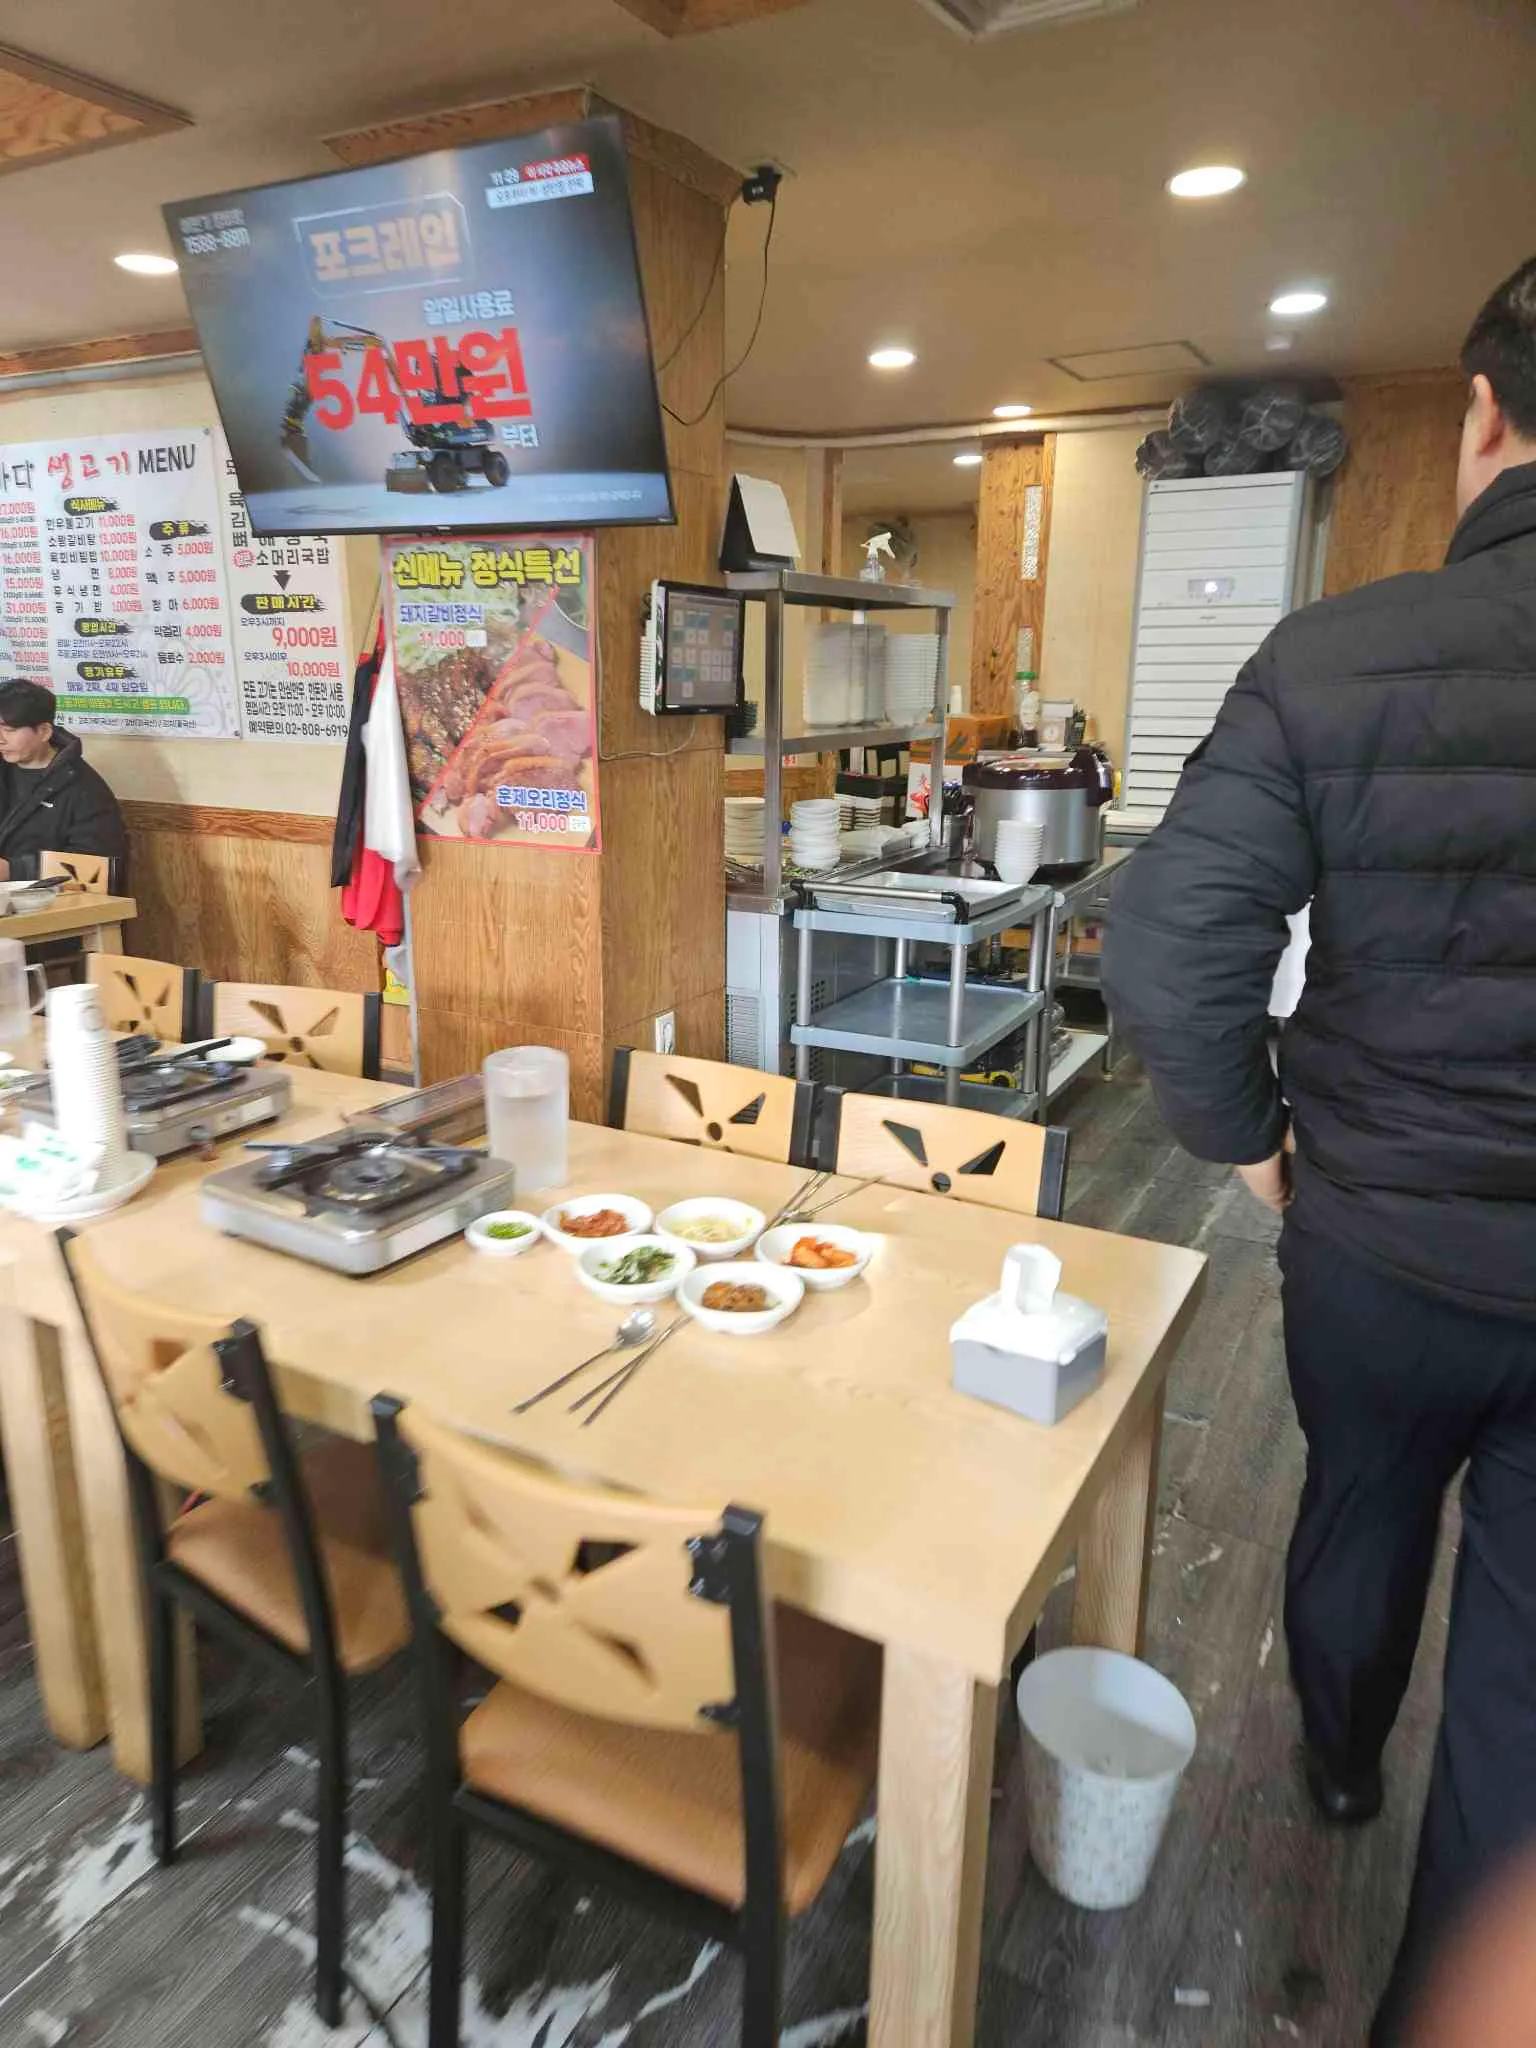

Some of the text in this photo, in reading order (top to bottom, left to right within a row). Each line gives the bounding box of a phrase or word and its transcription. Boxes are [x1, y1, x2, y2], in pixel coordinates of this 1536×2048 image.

[309, 211, 463, 281] 포크레인
[423, 289, 515, 325] 일일사용료
[303, 327, 533, 432] 54만원
[501, 423, 540, 448] 부터
[48, 451, 131, 490] 생고기
[138, 444, 196, 474] MENU
[256, 547, 329, 566] 소머리국밥
[394, 548, 581, 589] 신메뉴 정식특선
[255, 595, 315, 609] 판매시간
[399, 603, 482, 624] 돼지갈비정식
[272, 625, 338, 649] 9,000원
[497, 787, 586, 812] 훈제오리정식
